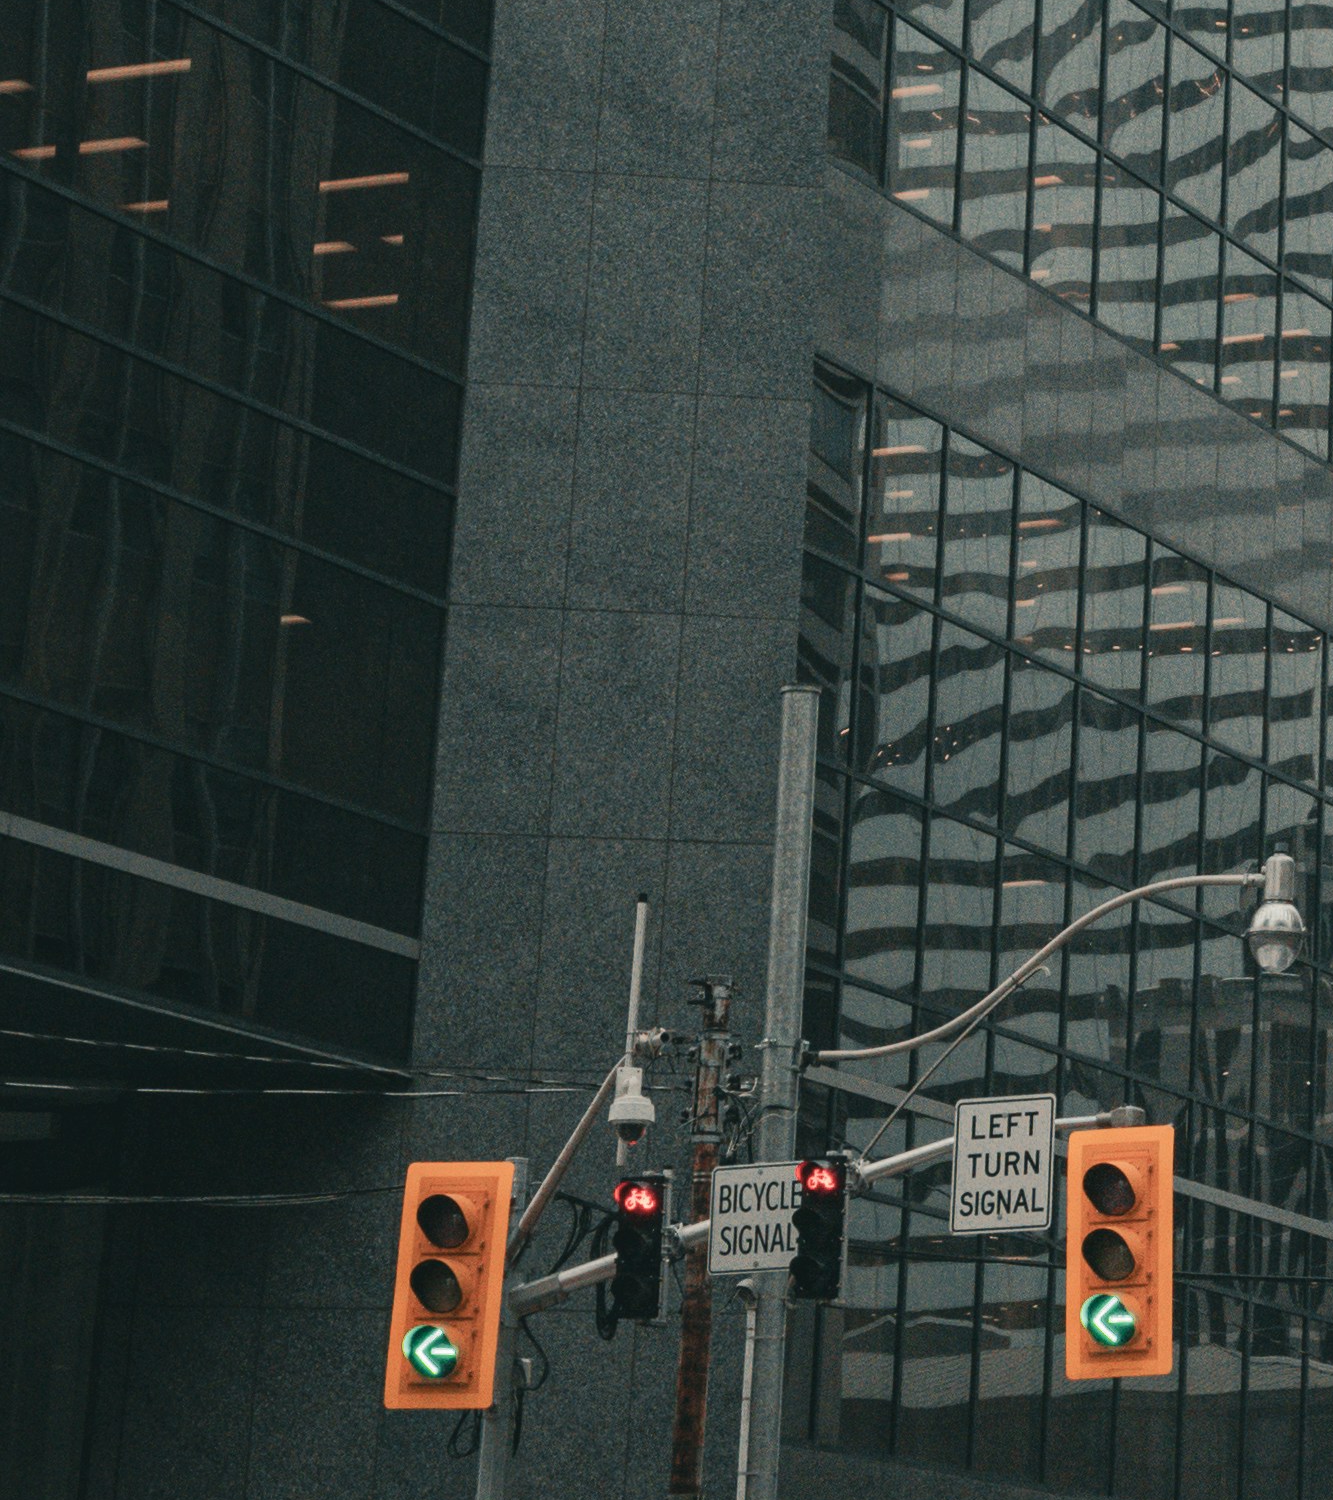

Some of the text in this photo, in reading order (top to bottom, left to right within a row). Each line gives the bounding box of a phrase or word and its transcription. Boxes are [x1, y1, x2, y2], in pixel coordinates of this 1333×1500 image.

[970, 1111, 1040, 1140] LEFT
[968, 1150, 1041, 1179] TURN
[719, 1180, 802, 1214] BICYCLE
[959, 1187, 1045, 1217] SIGNAL
[719, 1221, 796, 1257] SIGNAL
